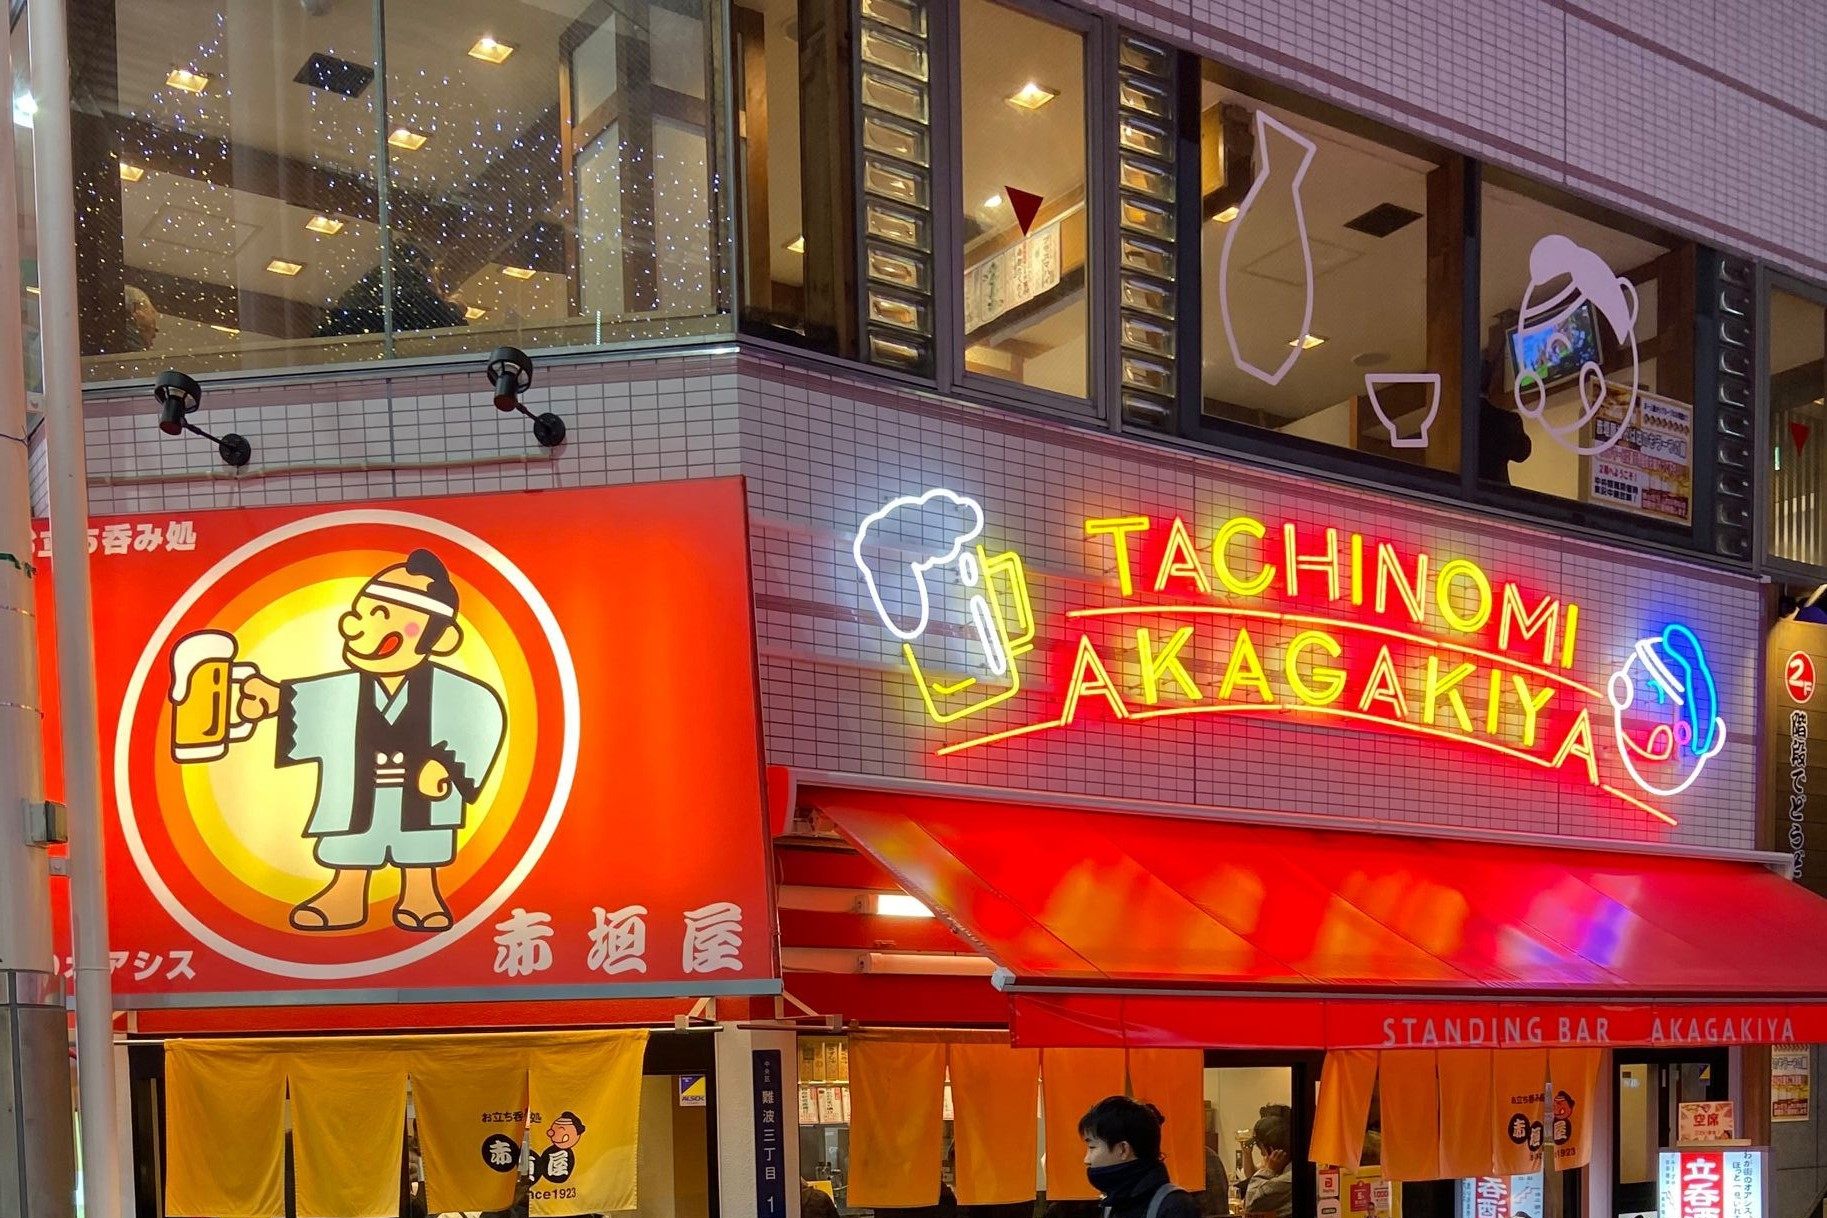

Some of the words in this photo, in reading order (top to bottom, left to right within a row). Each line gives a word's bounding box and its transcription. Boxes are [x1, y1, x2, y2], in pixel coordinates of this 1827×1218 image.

[33, 521, 197, 558] 呑み処
[1085, 515, 1579, 670] TACHINOMI
[1789, 658, 1812, 696] 2F
[1060, 626, 1600, 786] AKAGAKIYA
[494, 902, 743, 977] 赤垣屋
[53, 950, 196, 981] アシス
[1383, 1016, 1543, 1047] STANDING
[1559, 1017, 1609, 1044] BAR
[1651, 1017, 1796, 1043] AKAGAKIYA
[482, 1111, 542, 1123] お立ち呑処
[762, 1090, 776, 1180] 難波三丁目
[1693, 1113, 1718, 1127] 空席
[529, 1187, 577, 1199] nce1923
